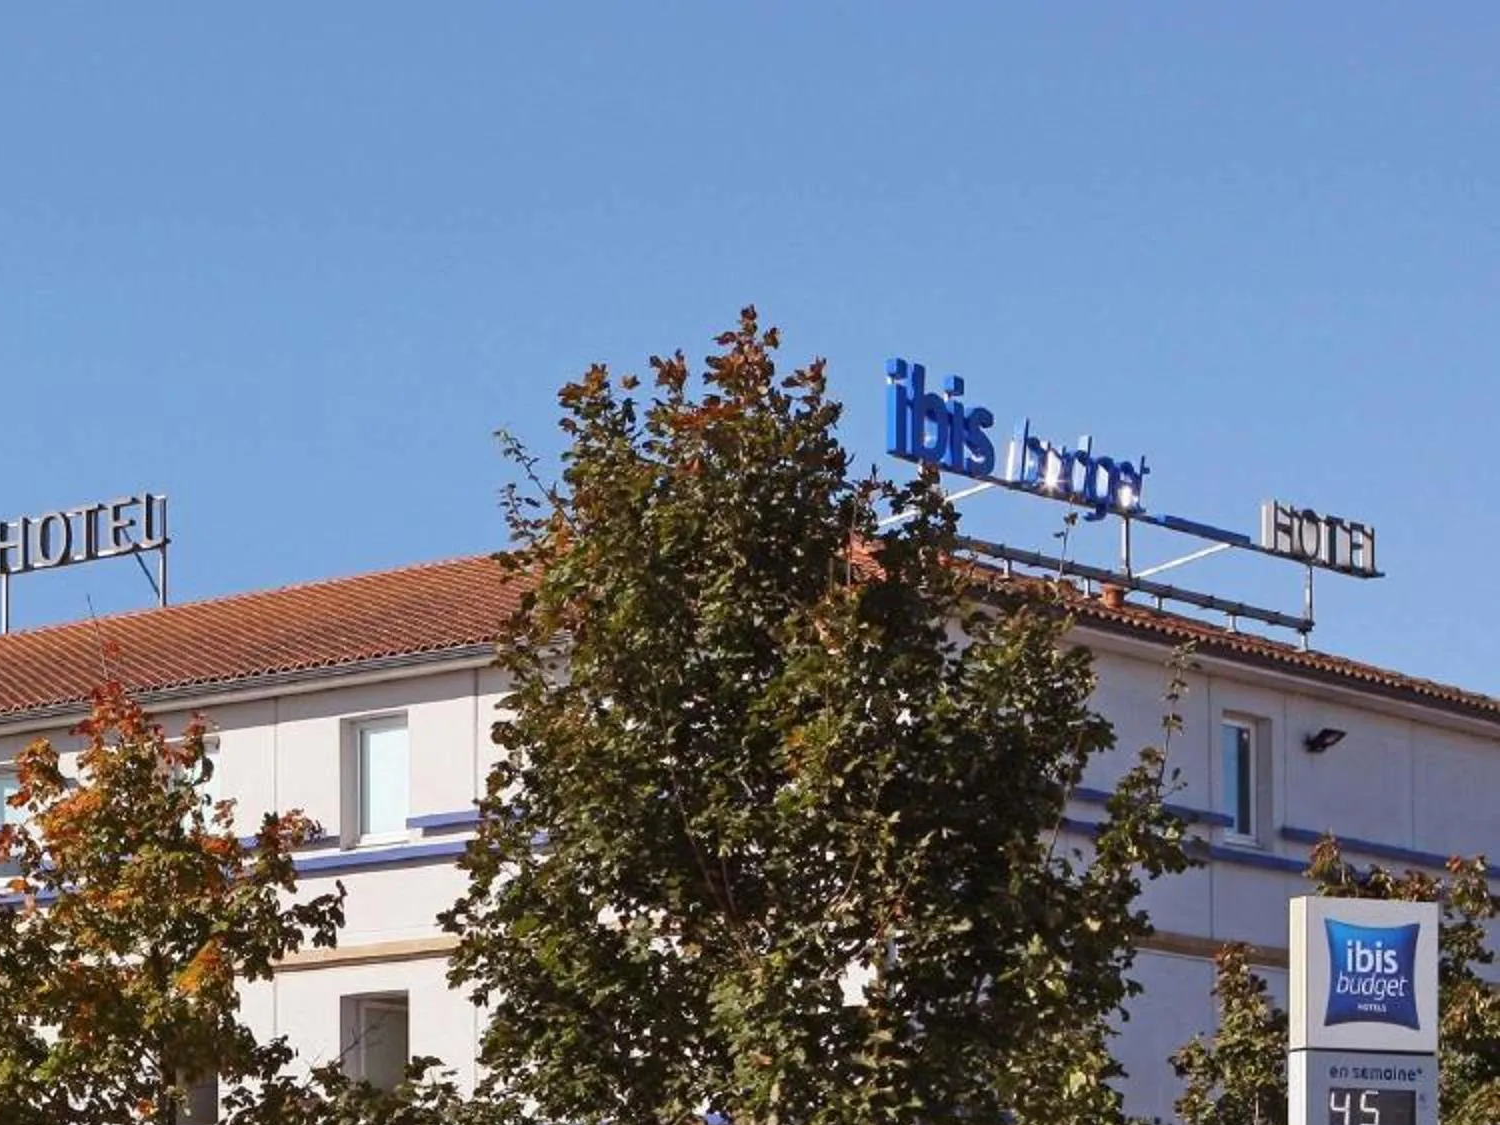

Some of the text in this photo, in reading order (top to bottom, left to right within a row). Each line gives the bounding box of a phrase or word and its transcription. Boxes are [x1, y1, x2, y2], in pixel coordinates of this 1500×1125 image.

[885, 358, 995, 478] ibis
[1346, 939, 1399, 974] ibis
[1336, 970, 1409, 1001] budget
[1357, 1003, 1387, 1013] HOTELS
[1329, 1066, 1348, 1079] en
